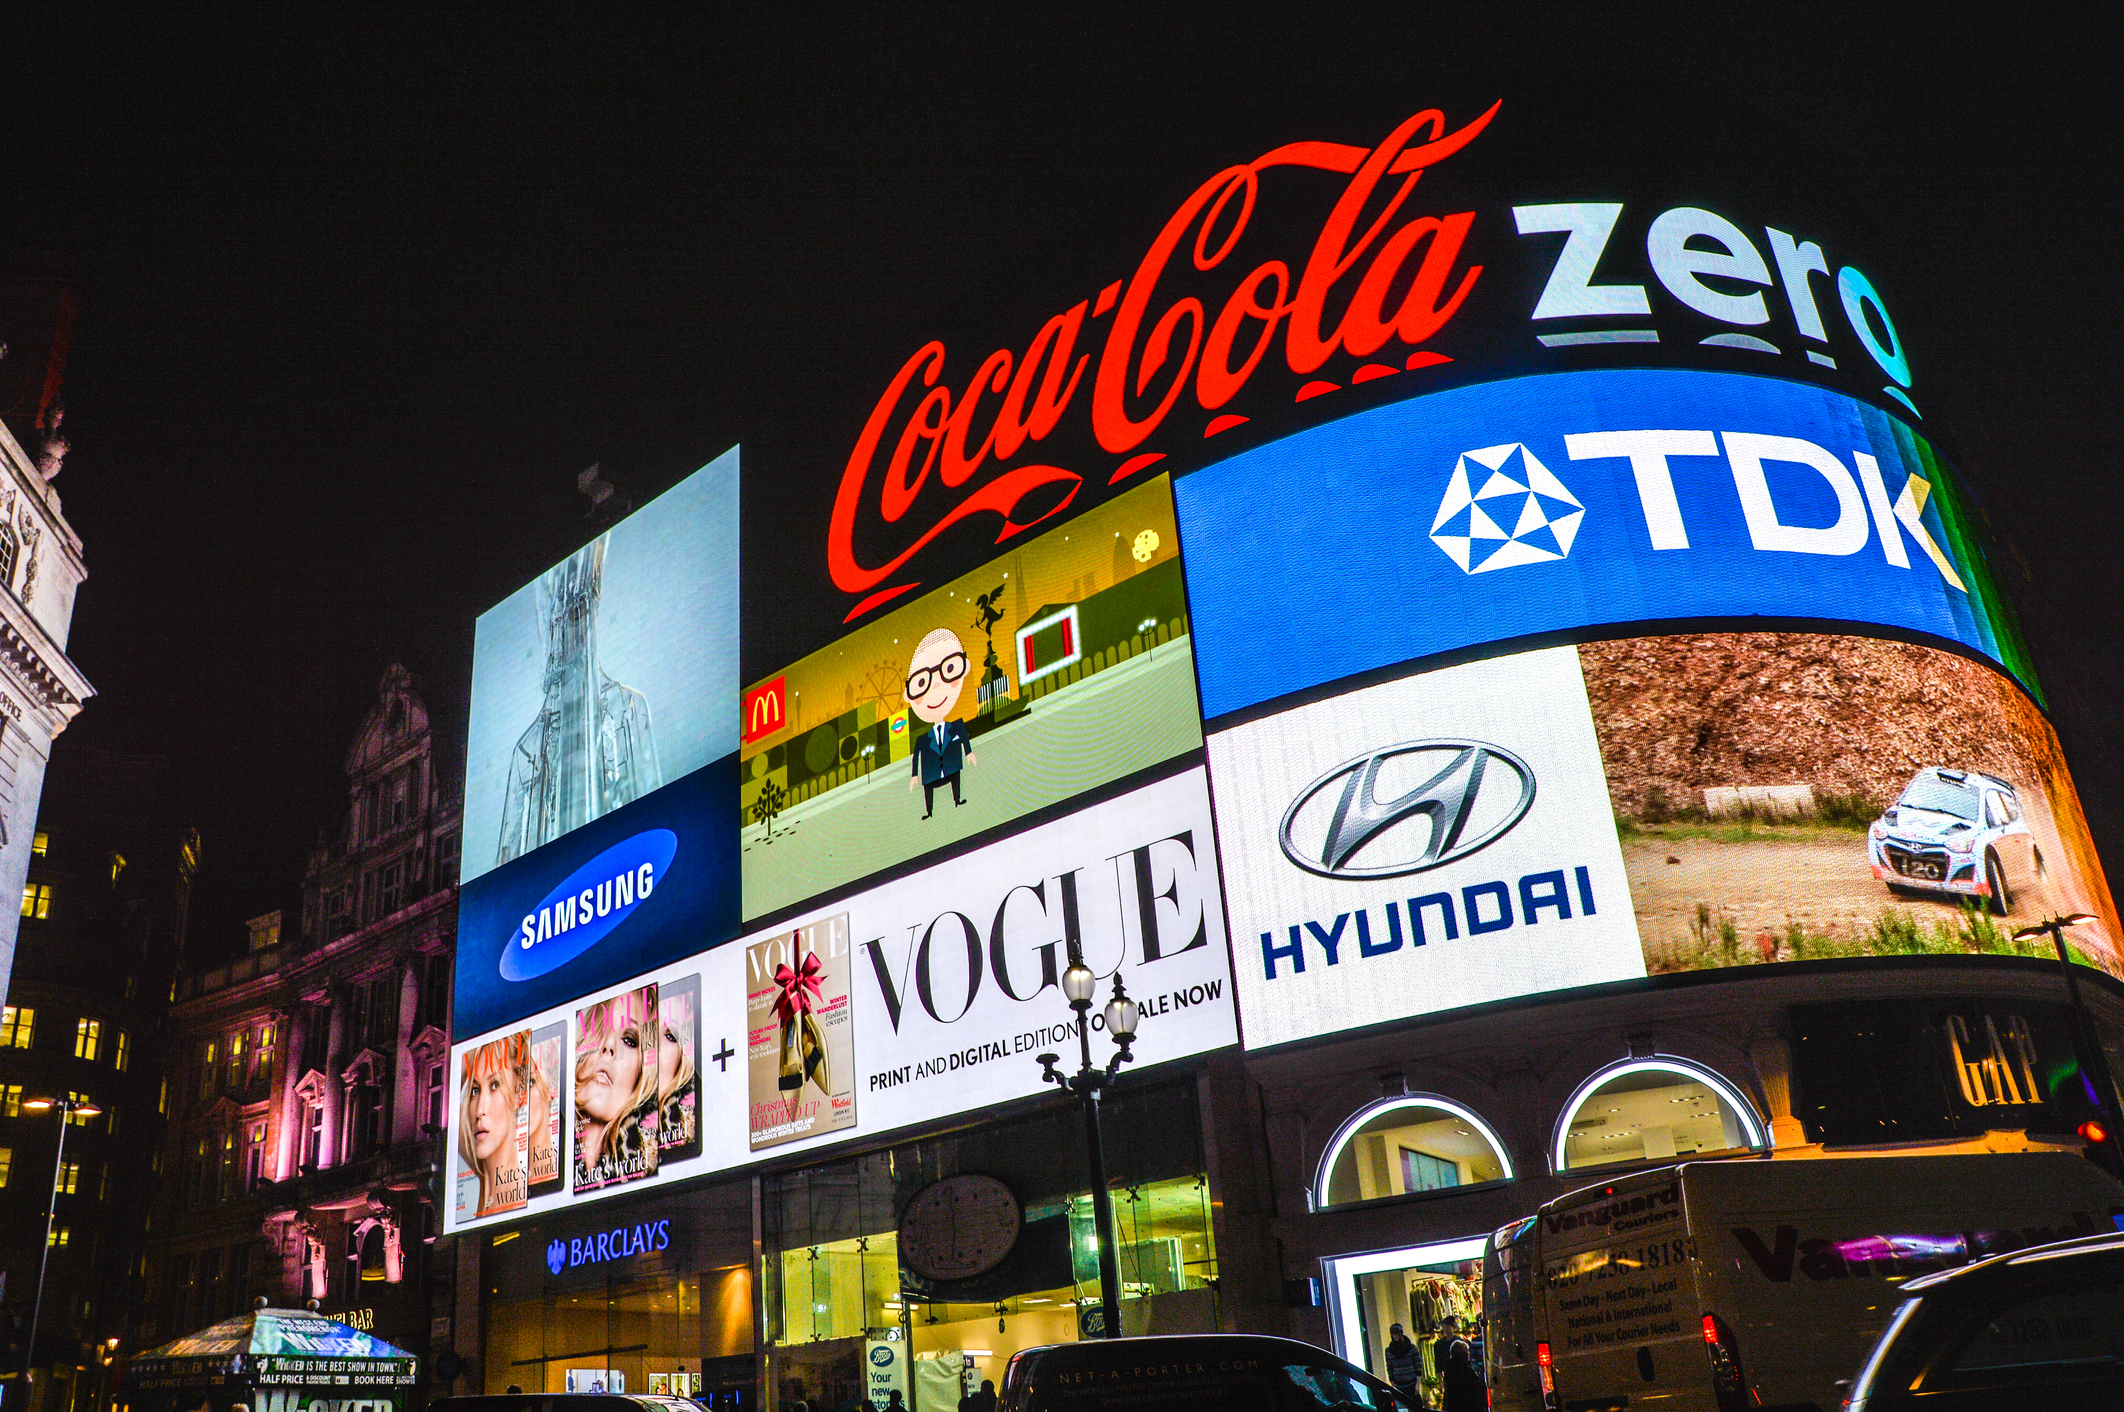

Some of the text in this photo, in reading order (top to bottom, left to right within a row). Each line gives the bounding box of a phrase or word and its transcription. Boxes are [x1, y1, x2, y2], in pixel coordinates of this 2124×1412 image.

[828, 99, 1912, 593] Coca-Cola zero
[1564, 430, 1968, 594] TDK
[521, 862, 653, 949] SAMSUNG
[859, 829, 1208, 1037] VOGUE
[1260, 865, 1596, 980] HYUNDAI
[748, 917, 848, 983] VOGUE
[578, 984, 657, 1041] VOGUE
[816, 1001, 848, 1015] WANDERLUST
[830, 994, 847, 1004] WINTER
[870, 979, 1223, 1092] PRINT AND DIGITAL EDITION O ALE NOW
[464, 1030, 530, 1081] VOGUE
[750, 1096, 799, 1116] Christmas
[804, 1100, 821, 1117] UP
[533, 1141, 558, 1163] Kate's
[495, 1161, 527, 1187] Kate's
[533, 1157, 558, 1177] world
[574, 1157, 611, 1187] Kate's
[614, 1148, 649, 1177] world
[496, 1181, 526, 1206] world
[1545, 1182, 1680, 1234] Vanguard
[1615, 1209, 1680, 1231] Couriers
[570, 1219, 670, 1267] BARCLAYS
[1559, 1278, 1677, 1312] Same Day Next Day Local
[349, 1308, 375, 1330] BAR
[1568, 1300, 1673, 1329] National & International
[1567, 1319, 1681, 1348] For All Your Courier Needs
[259, 1374, 281, 1384] HALF
[281, 1374, 304, 1384] PRICE
[306, 1360, 314, 1371] IS
[315, 1361, 328, 1372] THE
[329, 1361, 346, 1372] BEST
[347, 1361, 367, 1373] SHOW
[367, 1362, 376, 1373] IN
[354, 1375, 376, 1385] BOOK
[376, 1375, 394, 1385] HERE
[870, 1372, 892, 1383] Your
[872, 1388, 890, 1397] new
